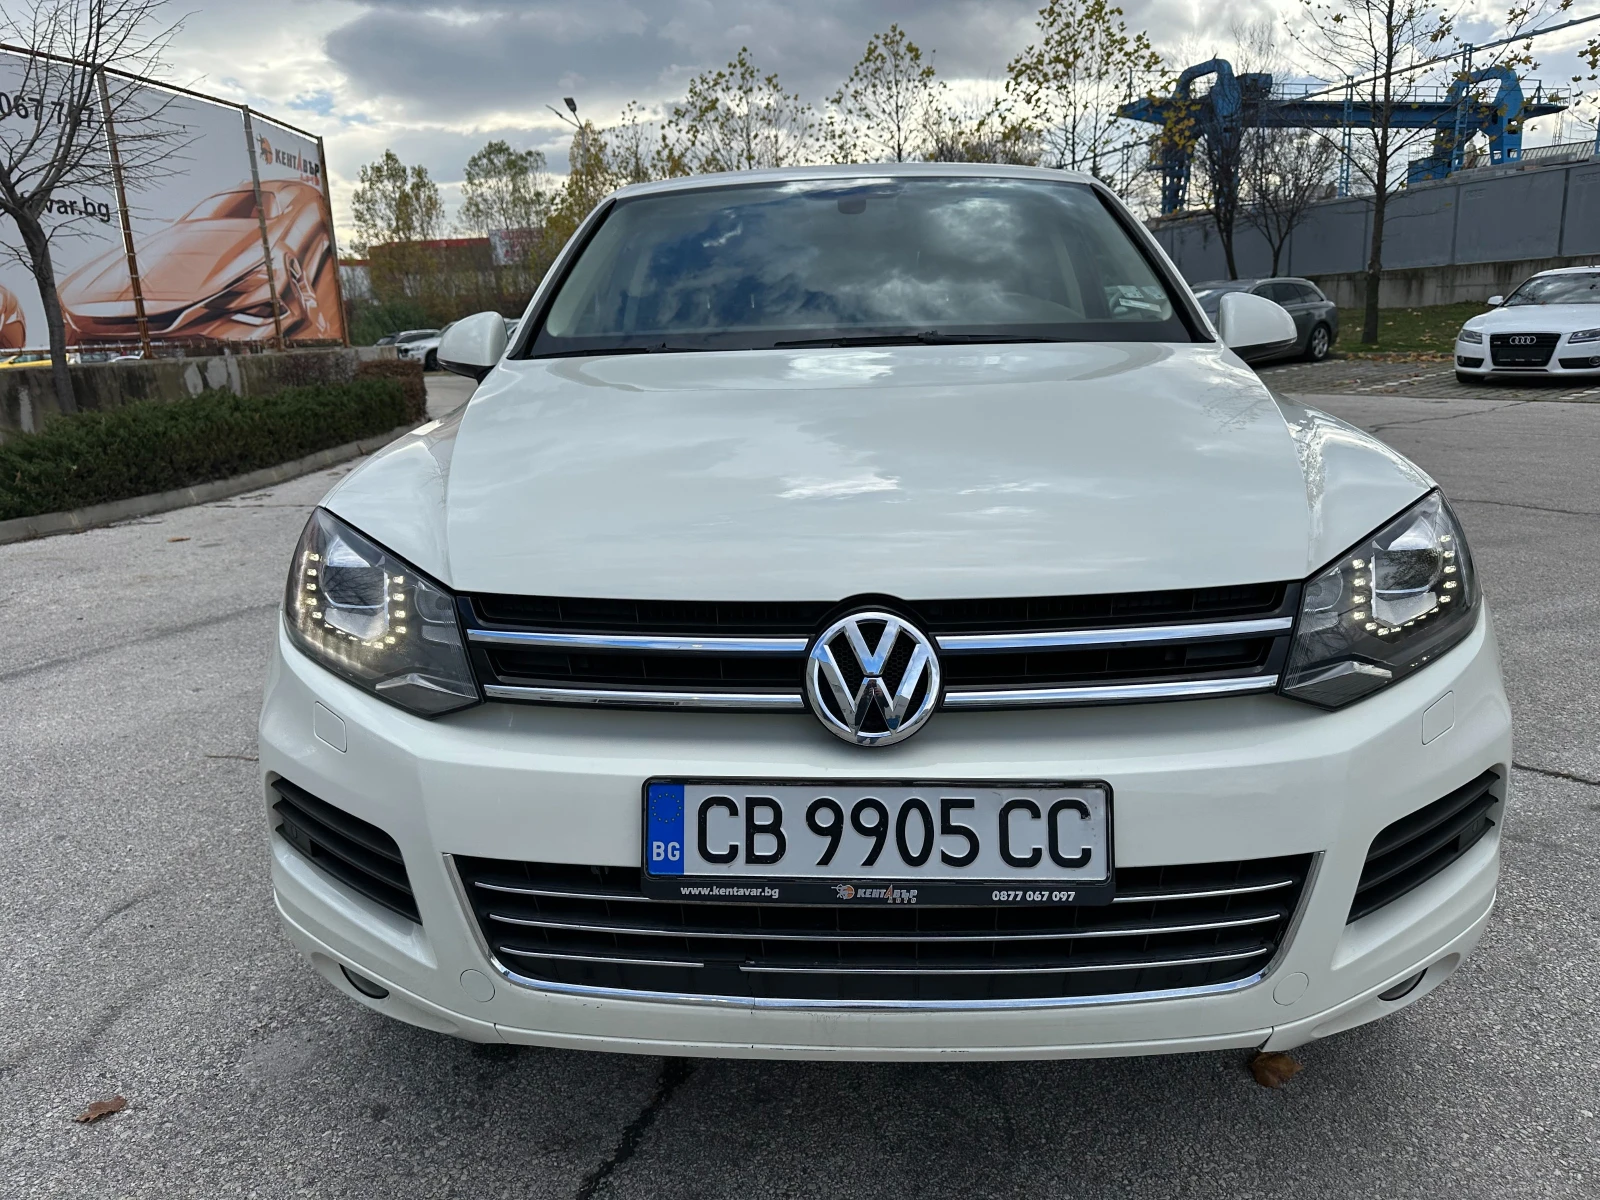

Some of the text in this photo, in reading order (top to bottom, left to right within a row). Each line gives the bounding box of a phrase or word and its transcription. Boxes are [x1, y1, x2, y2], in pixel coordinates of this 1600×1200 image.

[697, 795, 1092, 868] CB 9905 CC
[652, 841, 680, 861] BG
[680, 886, 779, 898] www.kentavar.bg
[992, 890, 1076, 901] 0877 067 097
